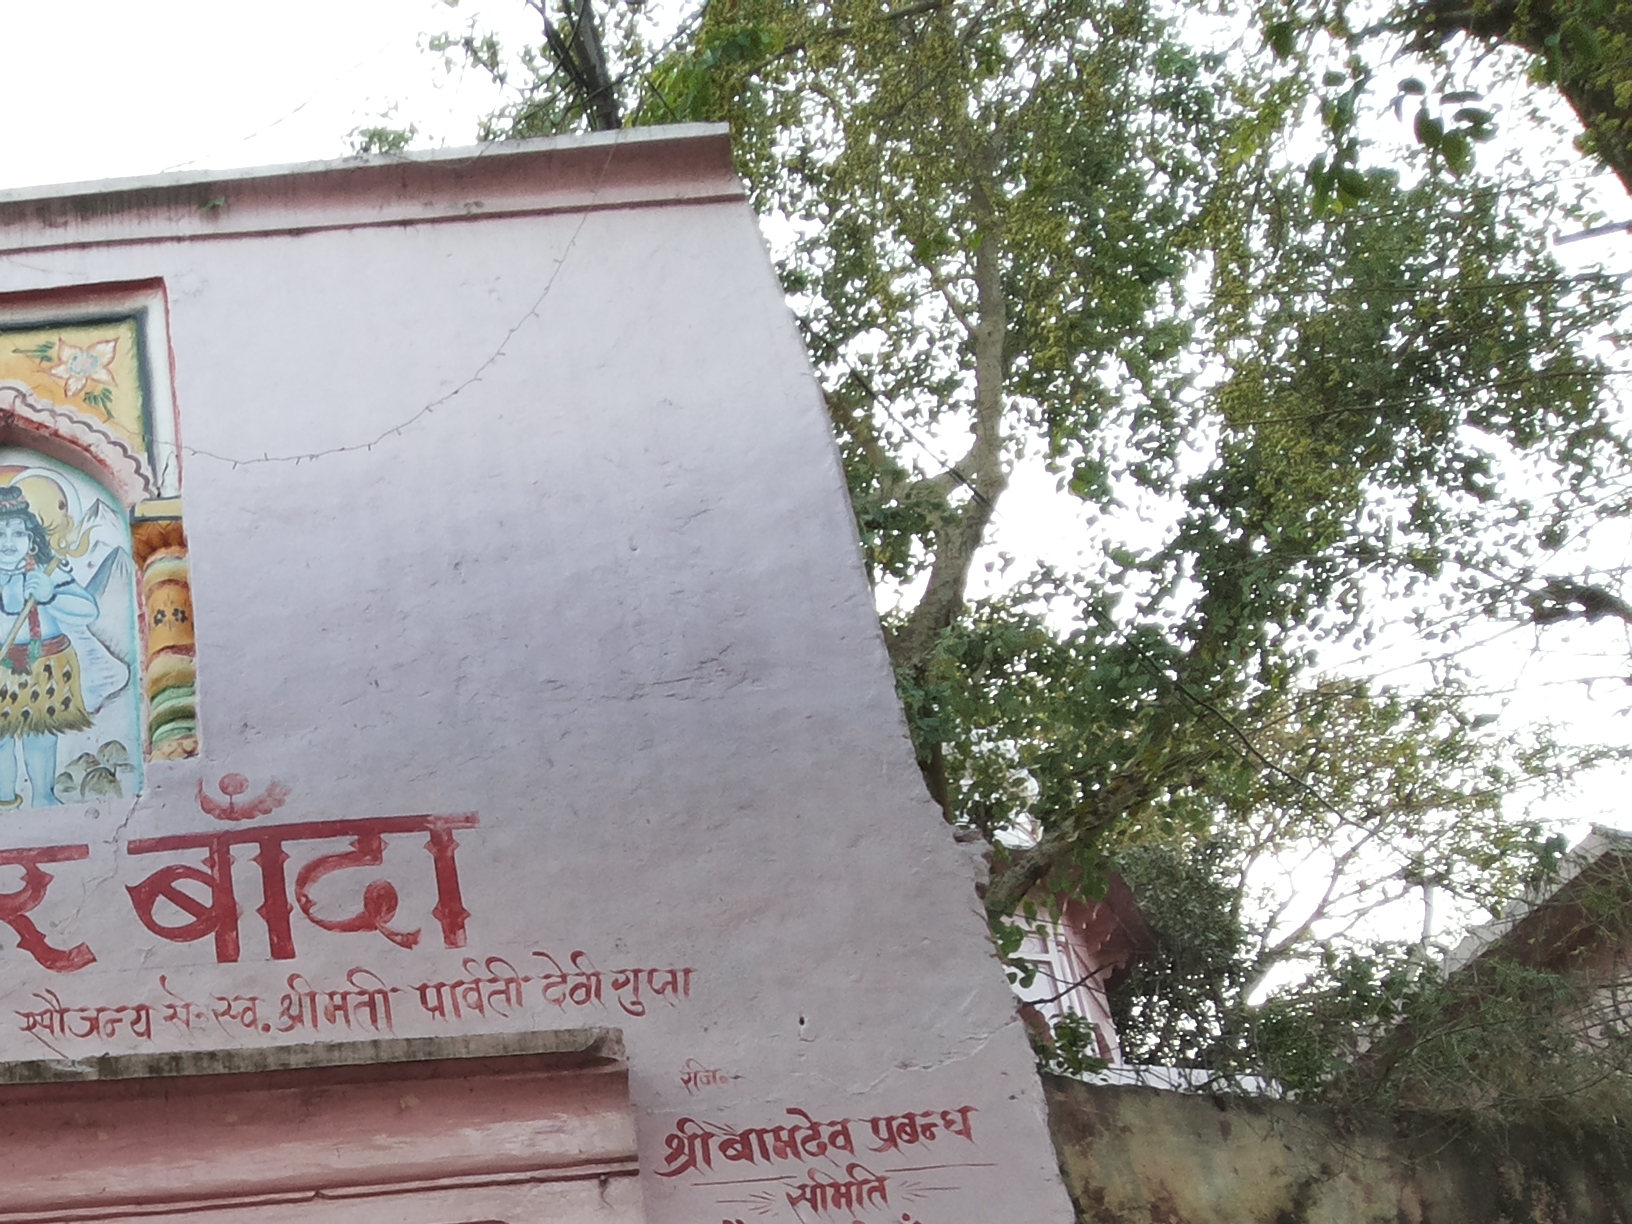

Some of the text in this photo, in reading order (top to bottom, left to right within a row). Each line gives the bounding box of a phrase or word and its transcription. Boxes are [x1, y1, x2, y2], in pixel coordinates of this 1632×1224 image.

[124, 773, 480, 964] बाँदा
[14, 988, 158, 1059] सौजन्य
[408, 956, 533, 1022] पार्वती
[531, 949, 609, 1014] देवी
[608, 966, 699, 1017] गुप्ता
[858, 1104, 979, 1159] प्रबन्ध
